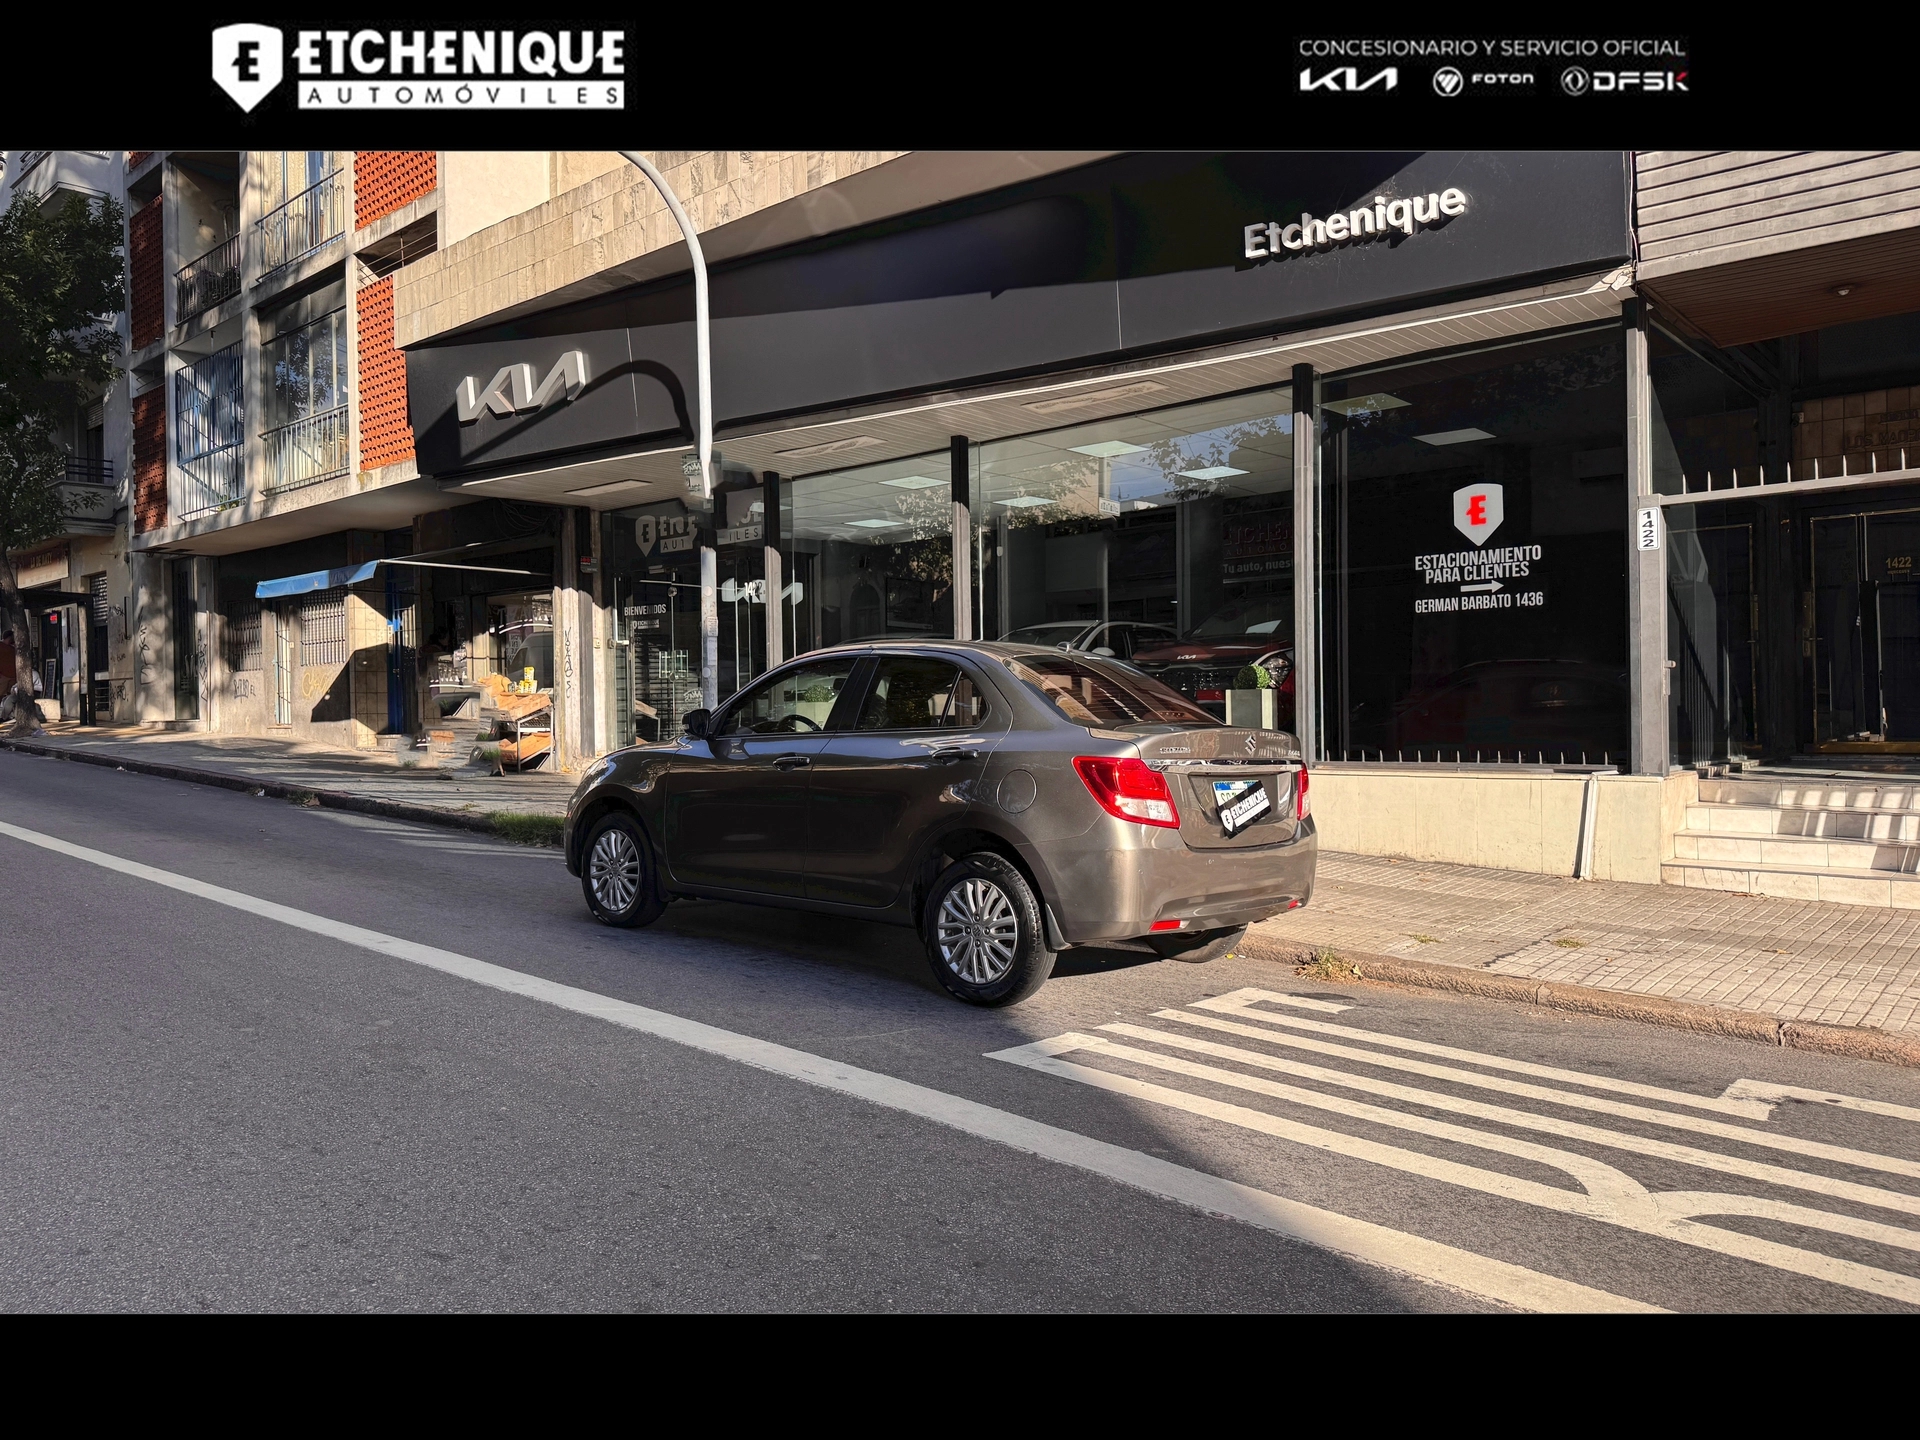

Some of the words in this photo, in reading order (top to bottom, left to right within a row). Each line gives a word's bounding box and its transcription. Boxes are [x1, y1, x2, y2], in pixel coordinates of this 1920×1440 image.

[1244, 187, 1467, 260] Etchenique
[455, 350, 587, 428] KIA
[1642, 510, 1655, 548] 1422
[1223, 563, 1235, 574] Tu
[1236, 561, 1263, 573] auto,
[1415, 544, 1542, 571] ESTACIONAMIENTO
[1885, 556, 1912, 569] 1422
[1425, 567, 1461, 585] PARA
[1464, 561, 1530, 582] CLIENTES
[624, 603, 667, 617] BIENVENIDOS
[1415, 596, 1459, 614] GERMAN
[1461, 593, 1512, 611] BARBATO
[1515, 591, 1544, 607] 1436
